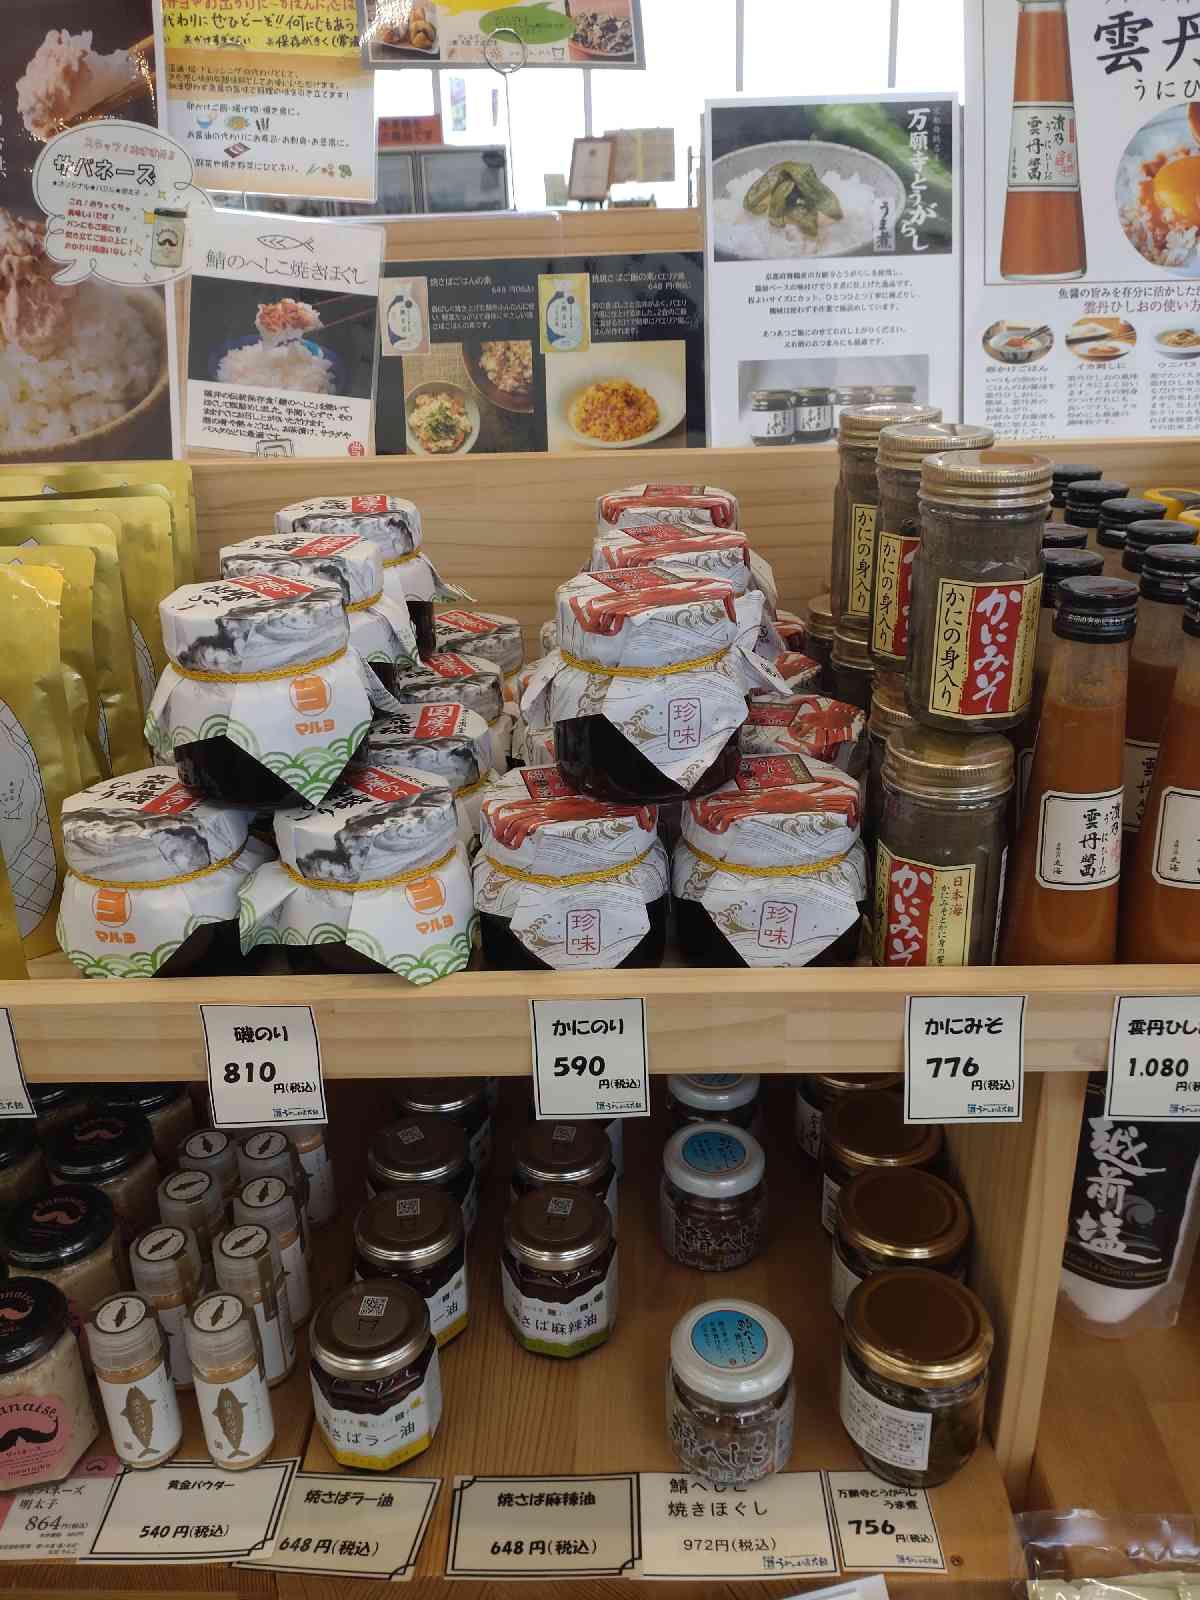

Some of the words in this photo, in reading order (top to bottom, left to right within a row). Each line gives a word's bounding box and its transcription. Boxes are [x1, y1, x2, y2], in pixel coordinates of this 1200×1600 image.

[857, 511, 872, 609] かにの身入り
[879, 541, 899, 652] かにの身入り
[944, 587, 967, 707] かにの身入り
[971, 588, 1022, 713] かにみそ
[672, 701, 699, 746] 珍味
[570, 914, 597, 953] 珍味
[763, 904, 795, 947] 珍味
[233, 1025, 289, 1043] 磯のり
[551, 1018, 625, 1037] かにのり
[924, 1017, 1004, 1037] かにみそ
[1127, 1019, 1200, 1037] 雲丹ひし
[223, 1061, 276, 1085] 810
[554, 1056, 606, 1077] 590
[926, 1057, 980, 1080] 776
[1128, 1058, 1190, 1078] 1.080
[273, 1081, 317, 1096] 円(税込)
[598, 1079, 642, 1090] 円(税込)
[971, 1080, 1016, 1093] 円(税込)
[167, 1479, 236, 1492] 黄金パウダー
[837, 1487, 919, 1499] 万願寺とうがらし
[18, 1498, 60, 1511] 明太子
[303, 1488, 396, 1509] 焼さばラー油
[497, 1491, 597, 1509] 焼さば麻辣油
[883, 1499, 920, 1511] うま煮
[667, 1500, 768, 1518] 焼きほぐし
[24, 1515, 63, 1532] 864
[138, 1524, 171, 1539] 540
[173, 1523, 231, 1539] 円(税込)
[847, 1519, 897, 1536] 756
[279, 1536, 312, 1553] 648
[315, 1539, 381, 1558] 円(税込)
[490, 1540, 525, 1556] 648
[528, 1539, 598, 1556] 円(税込)
[683, 1538, 777, 1554] 972円(税込)
[895, 1535, 935, 1545] 円(税込)
